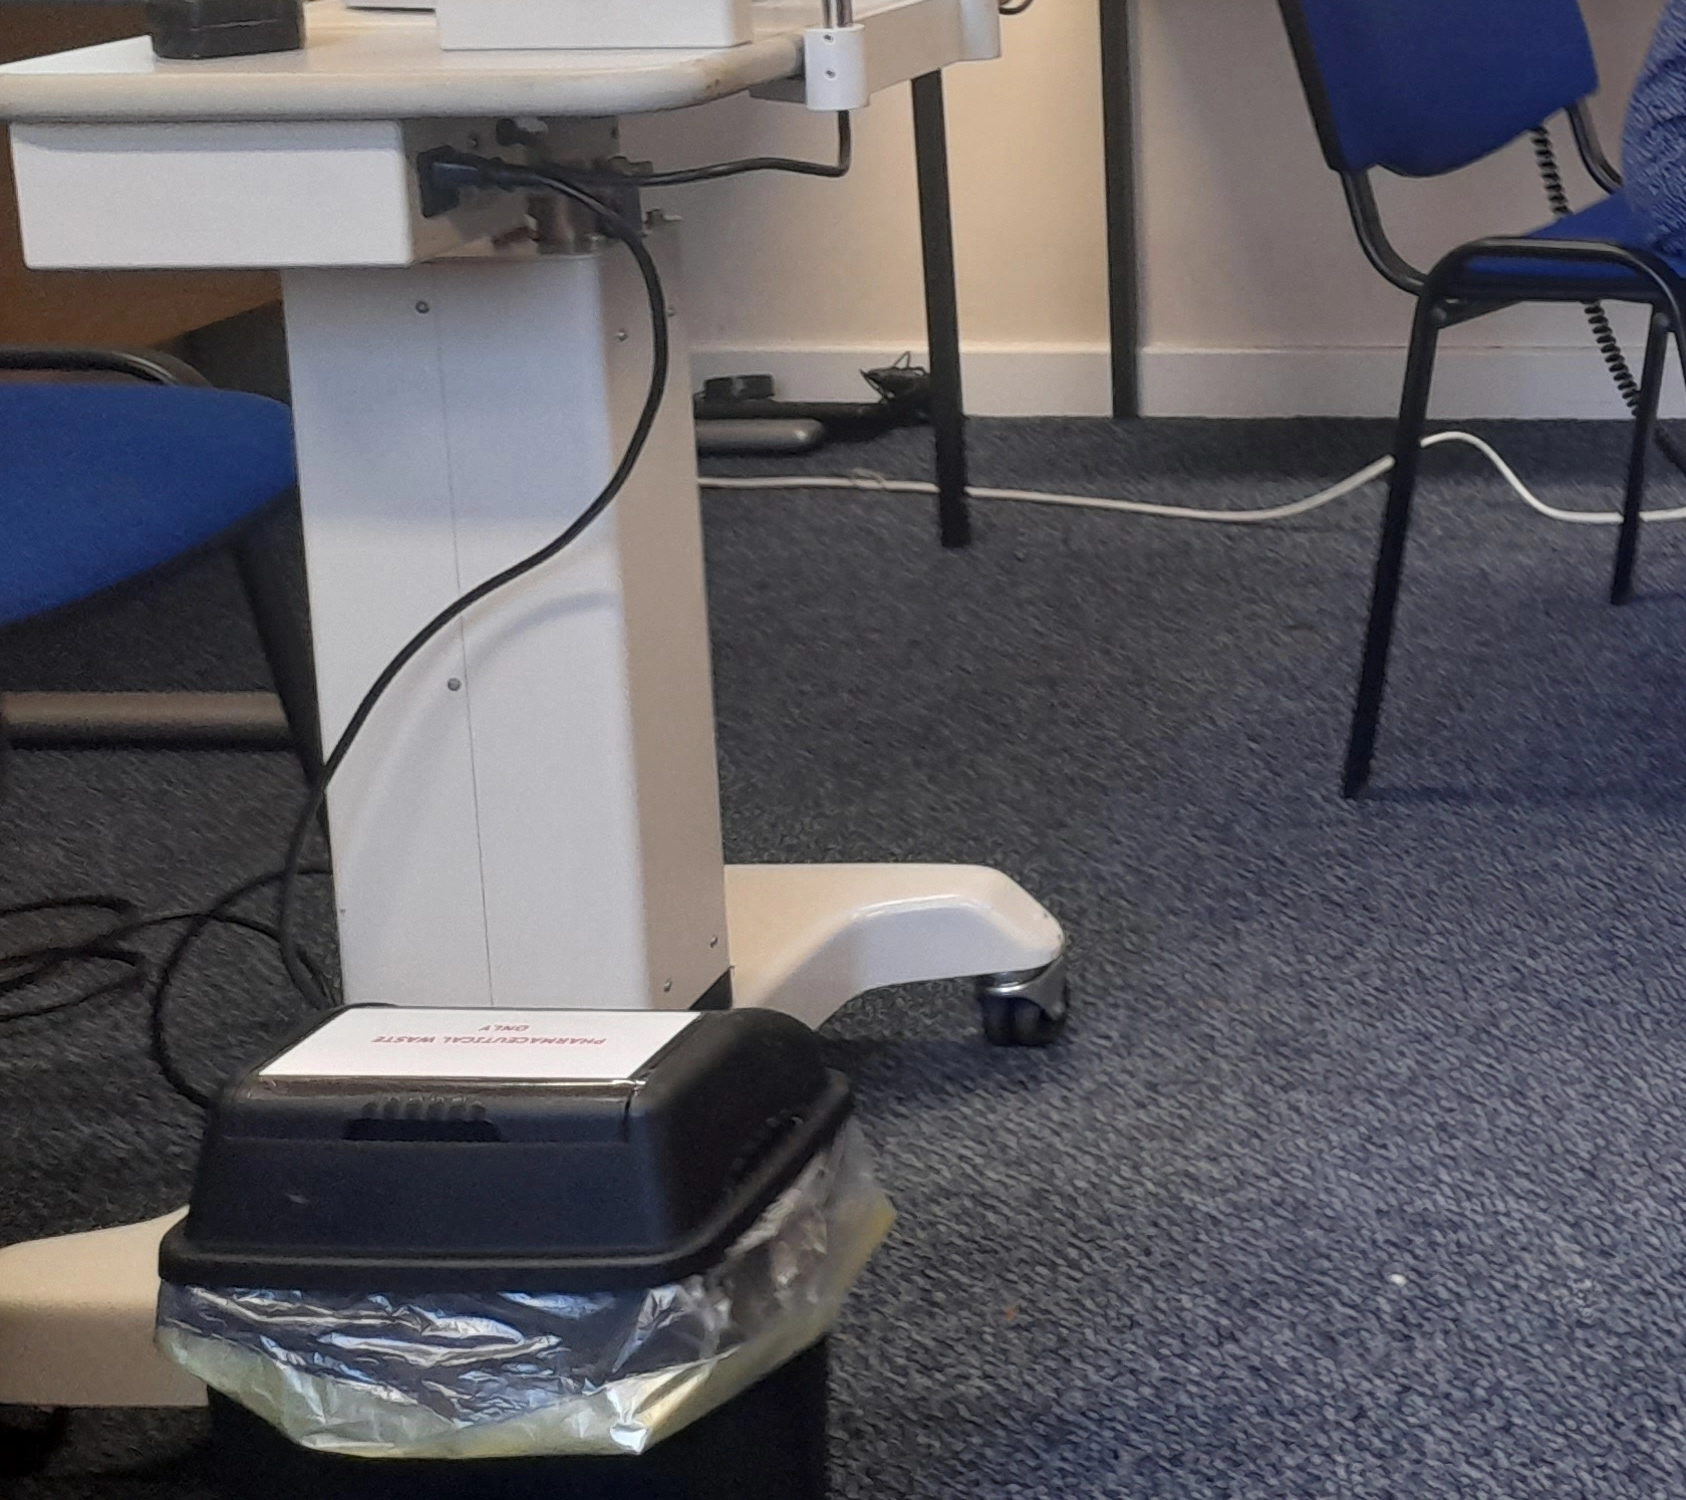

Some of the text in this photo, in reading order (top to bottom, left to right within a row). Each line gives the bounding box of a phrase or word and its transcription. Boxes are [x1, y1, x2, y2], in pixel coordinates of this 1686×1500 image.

[478, 1024, 529, 1032] ONLY
[371, 1035, 607, 1045] PHARMACEUTICAL WASTE
